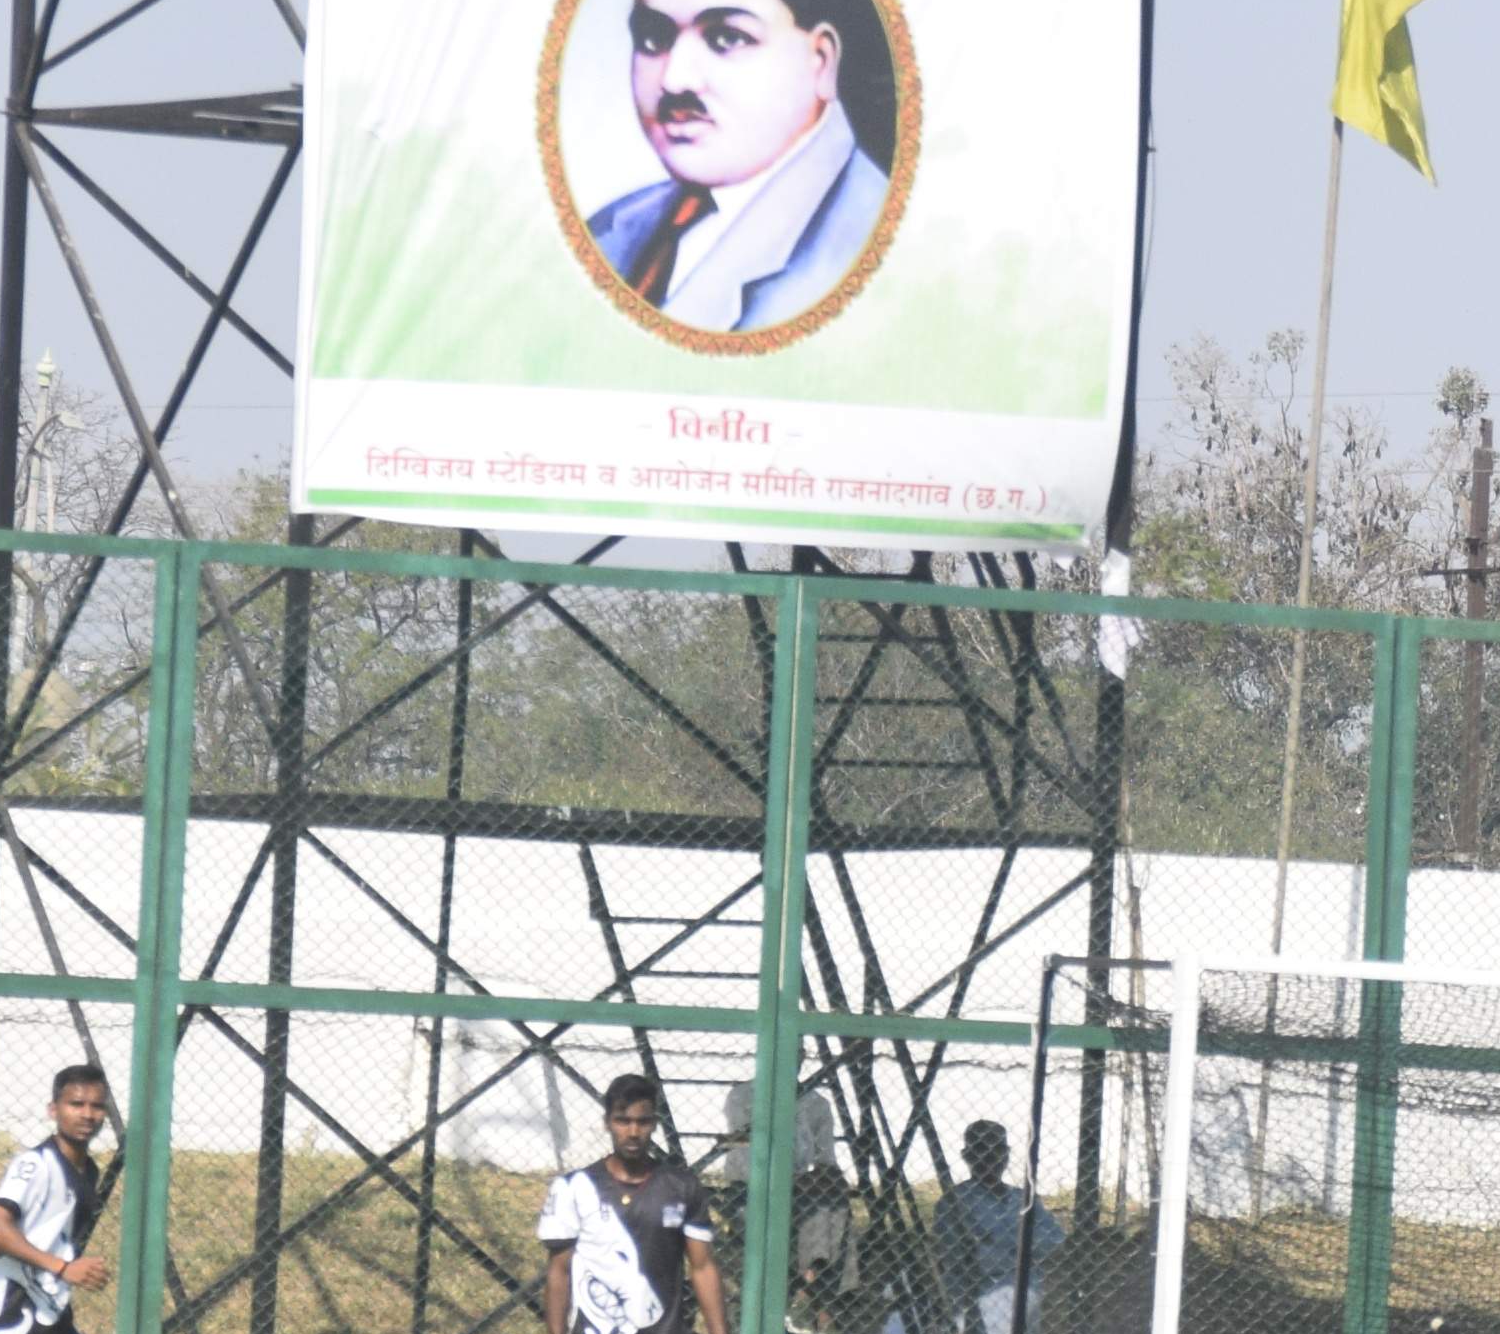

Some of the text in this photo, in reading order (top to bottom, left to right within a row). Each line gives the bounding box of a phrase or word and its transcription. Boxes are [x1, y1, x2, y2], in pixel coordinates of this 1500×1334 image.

[668, 405, 772, 444] विनीत
[366, 446, 474, 479] दिग्विजय
[485, 451, 586, 485] स्टेडियम
[598, 465, 618, 486] व
[630, 459, 730, 494] आयोजन
[742, 468, 816, 499] समिति
